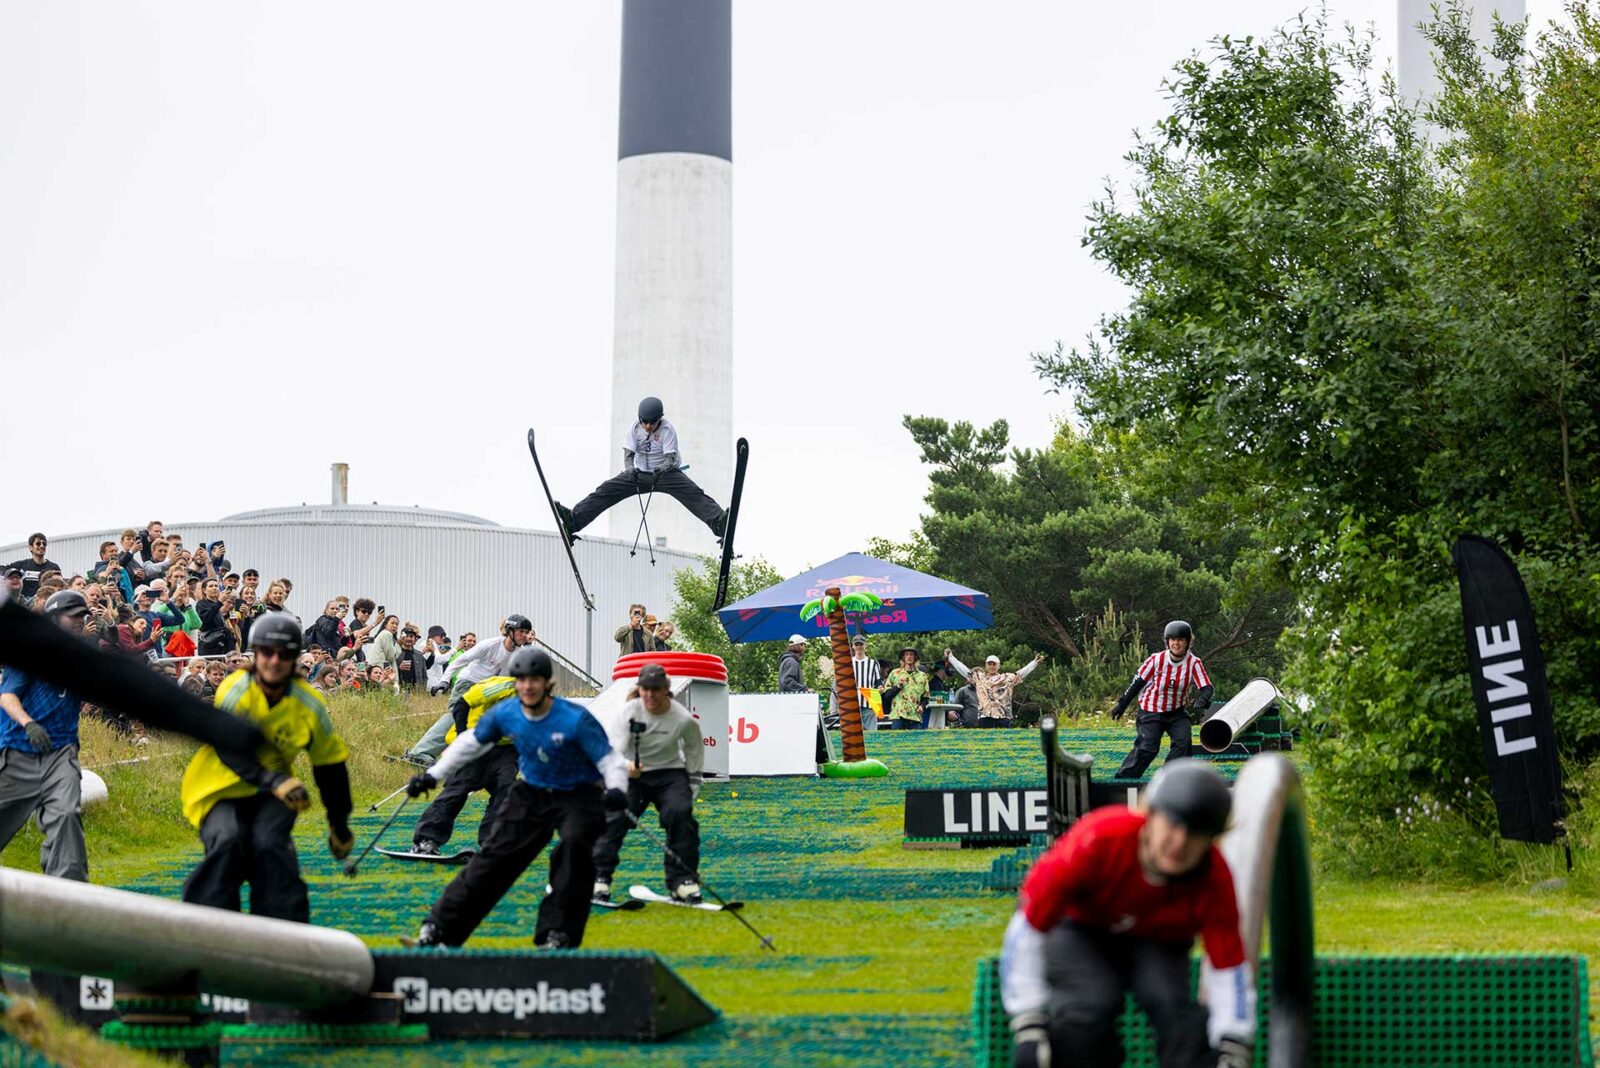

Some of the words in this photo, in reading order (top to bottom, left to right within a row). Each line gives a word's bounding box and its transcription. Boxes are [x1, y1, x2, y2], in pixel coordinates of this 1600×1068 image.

[645, 441, 651, 452] 3
[1475, 619, 1538, 757] LINE
[943, 791, 1047, 833] LINE
[429, 981, 606, 1020] neveplast
